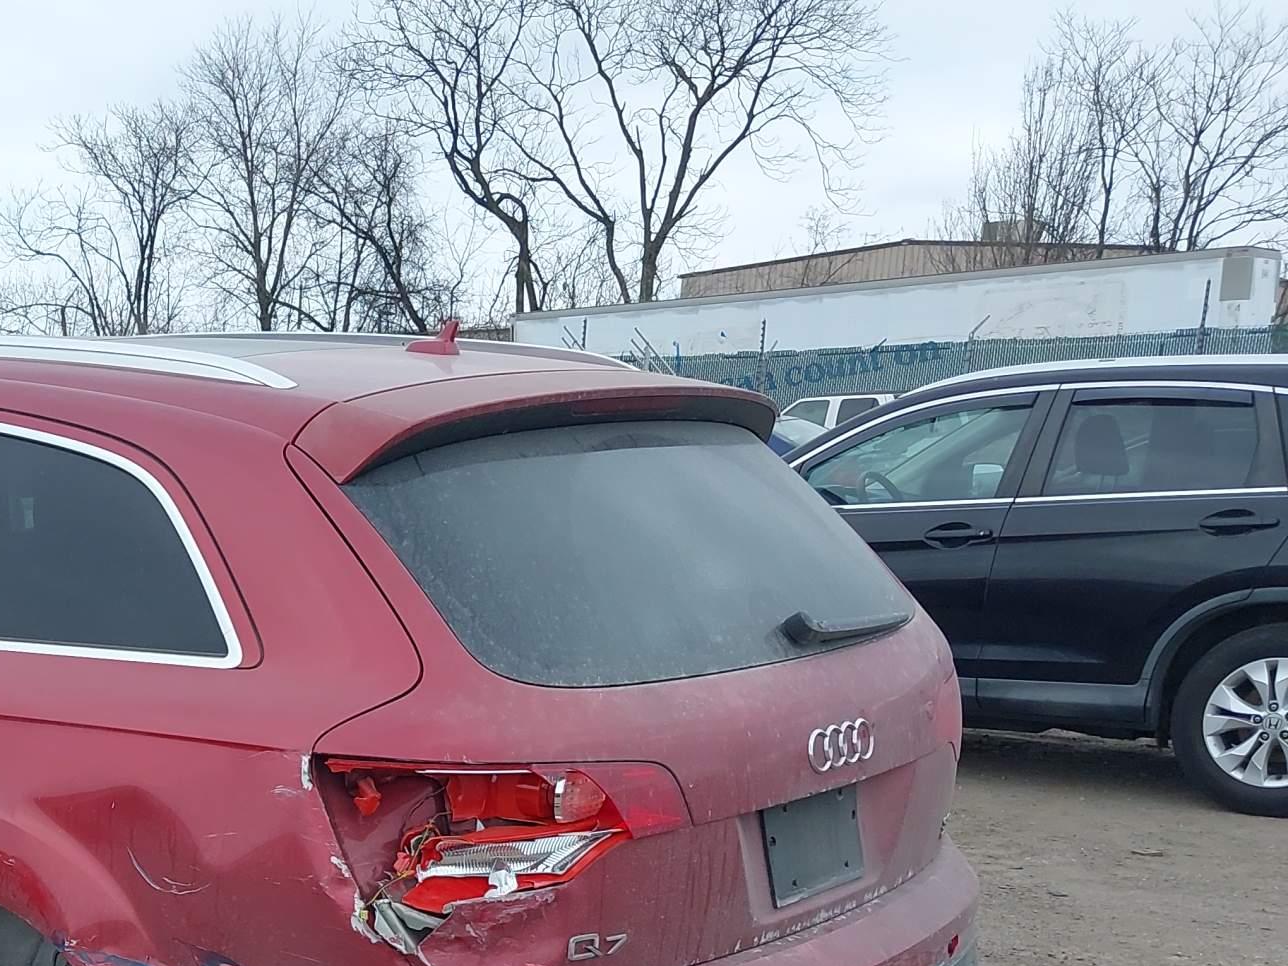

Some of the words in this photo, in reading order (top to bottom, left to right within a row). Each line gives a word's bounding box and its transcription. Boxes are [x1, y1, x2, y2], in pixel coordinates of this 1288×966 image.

[785, 348, 885, 387] count
[895, 341, 942, 366] on
[568, 933, 627, 961] Q7
